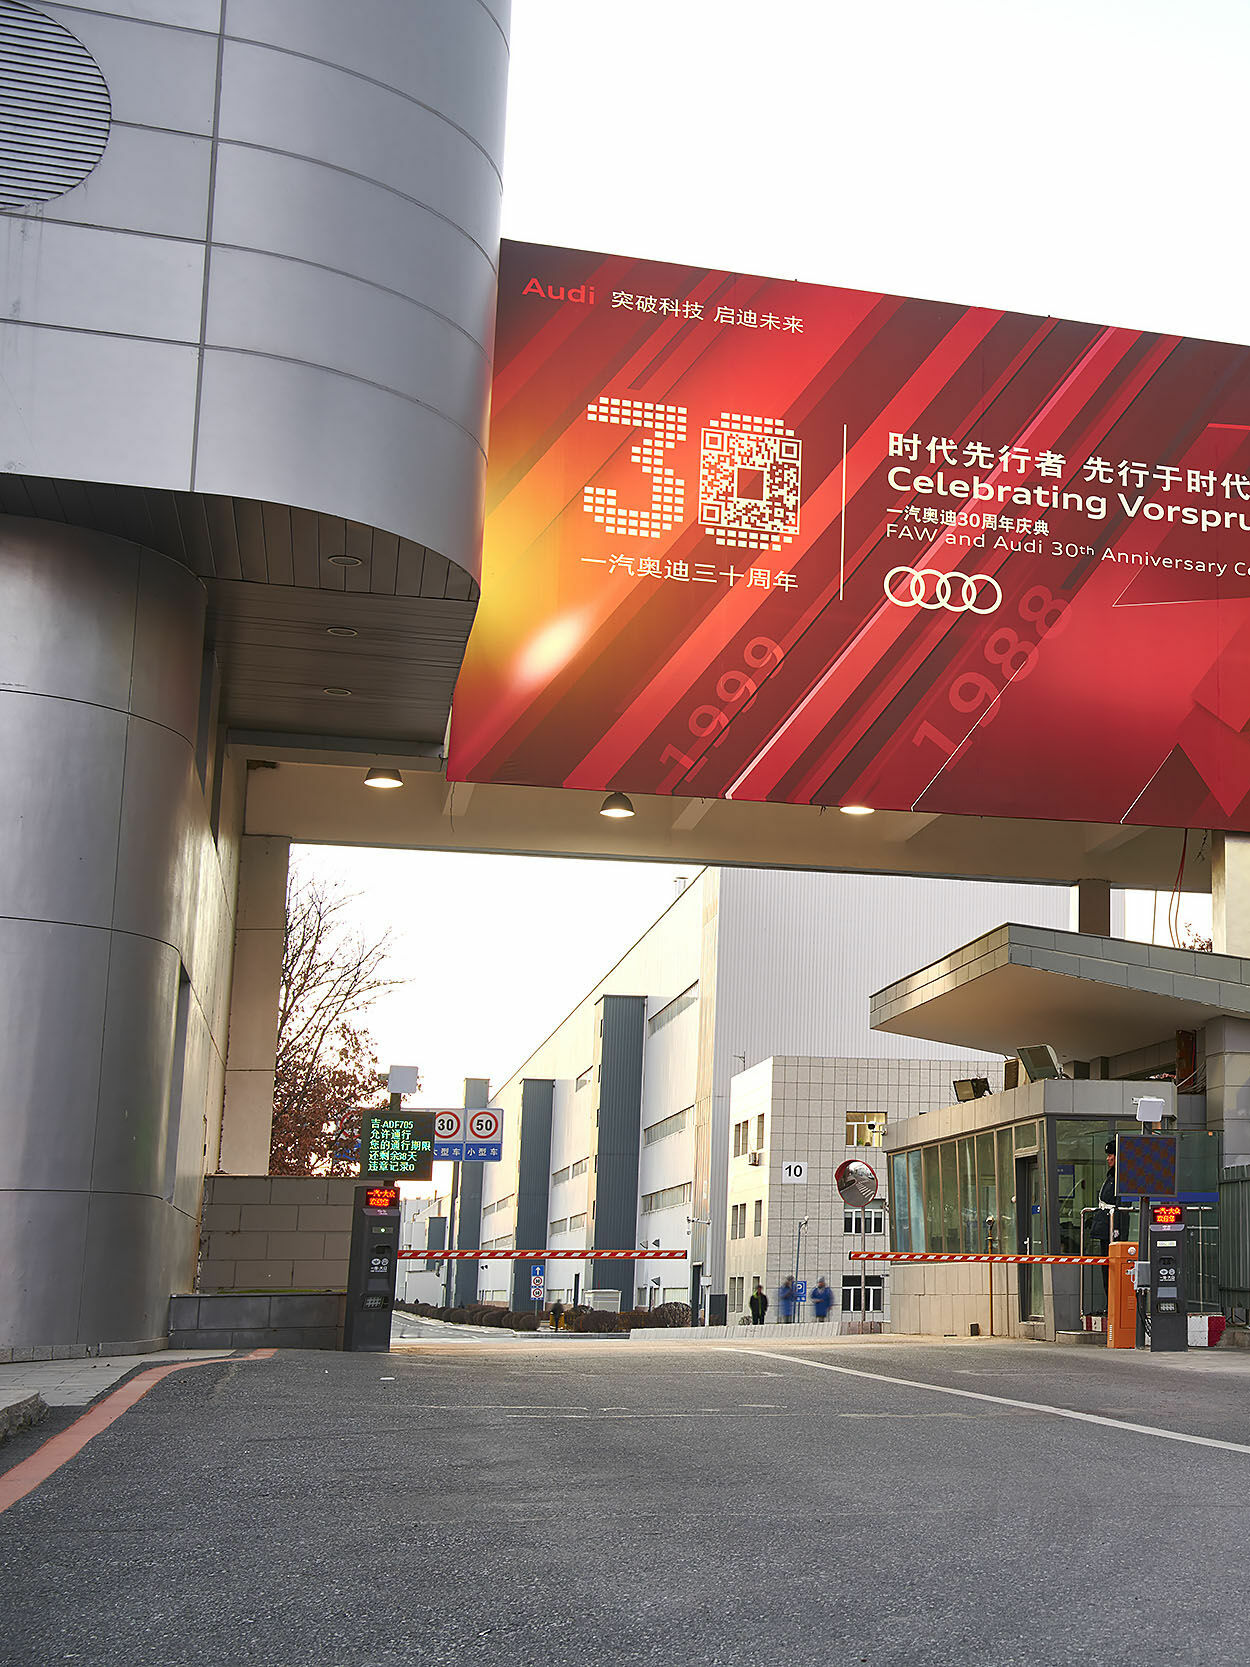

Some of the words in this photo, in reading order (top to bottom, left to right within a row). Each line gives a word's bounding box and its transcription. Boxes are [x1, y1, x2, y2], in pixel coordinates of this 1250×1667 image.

[522, 278, 596, 305] Audi
[611, 290, 704, 322] 突破科技
[713, 305, 805, 334] 启迪未来
[887, 431, 1067, 479] 时代先行者
[887, 466, 1107, 520] Celebrating
[886, 504, 1050, 537] 一汽奥迪30周年庆典
[886, 523, 938, 543] FAW
[944, 532, 985, 549] and
[993, 535, 1044, 555] Audi
[1051, 540, 1095, 558] 30th
[1101, 546, 1228, 577] Anniversary
[581, 554, 799, 592] 一汽奥迪三十周年
[912, 585, 1073, 772] 1988
[660, 636, 787, 784] 1999
[370, 1129, 412, 1140] 允许通行
[438, 1119, 454, 1131] 30
[476, 1119, 493, 1131] 50
[369, 1140, 432, 1151] 您的通行期限
[467, 1148, 498, 1157] 小型车
[785, 1164, 803, 1178] 10
